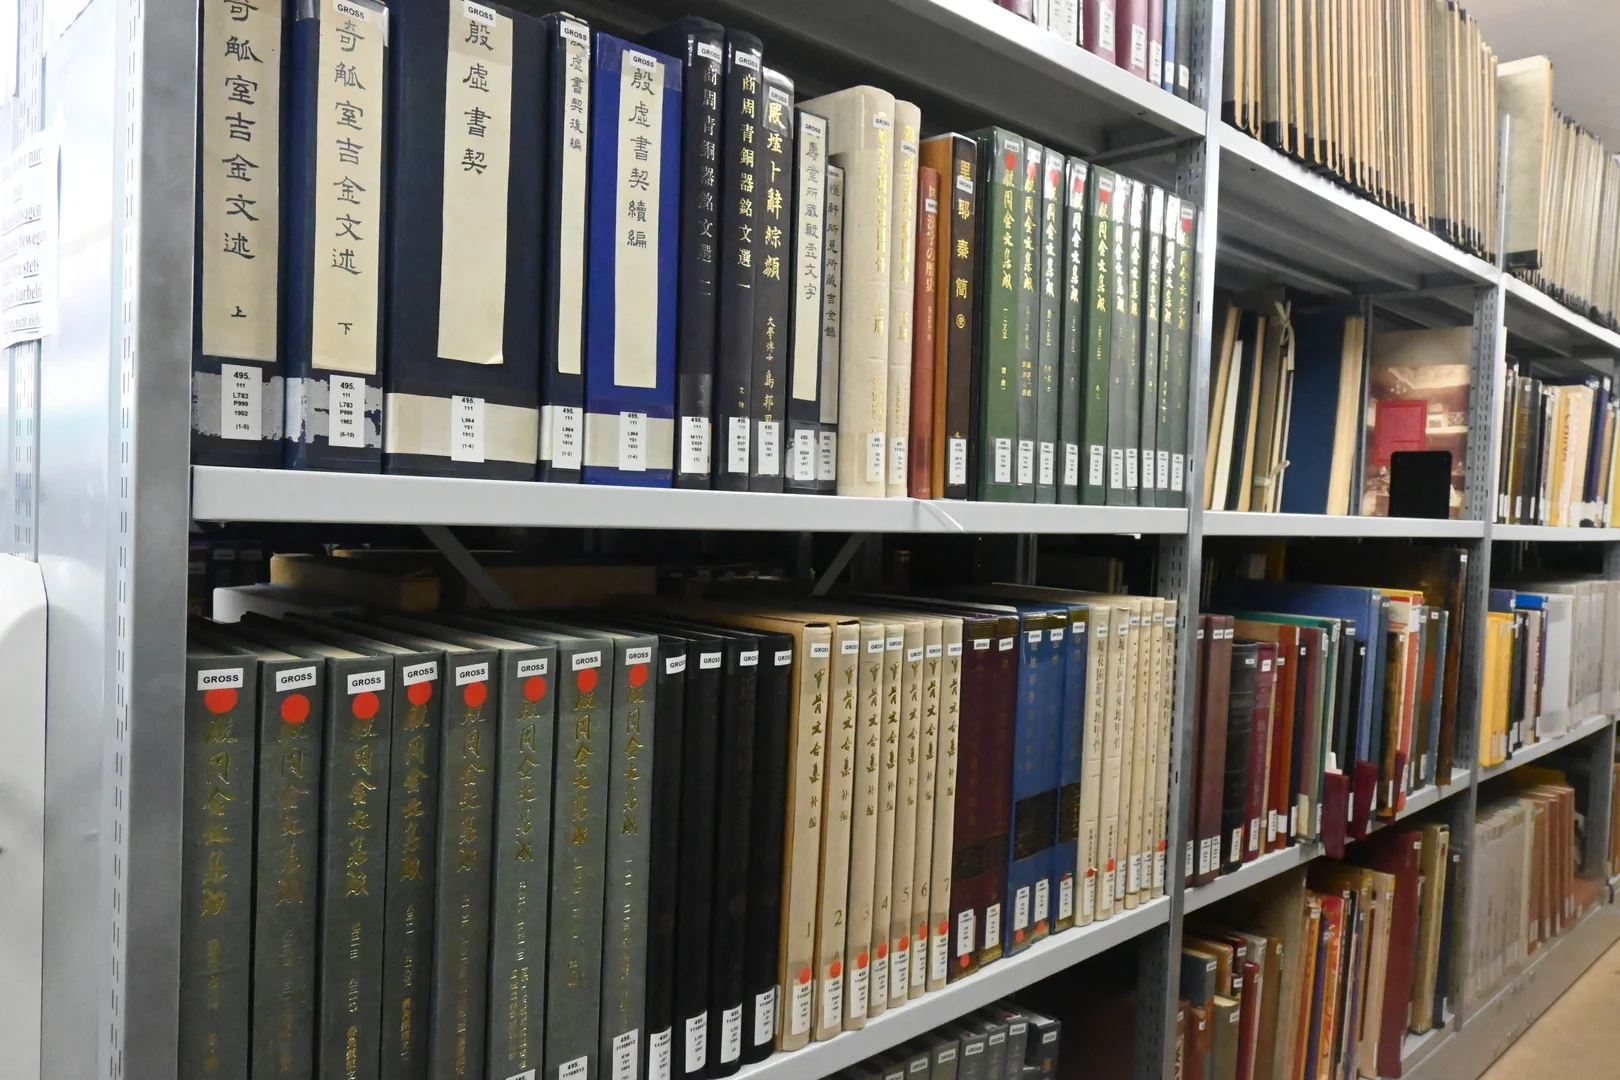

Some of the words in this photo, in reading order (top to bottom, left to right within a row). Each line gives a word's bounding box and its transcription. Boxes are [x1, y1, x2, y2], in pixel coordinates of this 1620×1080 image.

[337, 3, 365, 19] GROSS
[468, 7, 494, 21] GROSS
[564, 27, 587, 41] GROSS
[702, 48, 720, 60] GROSS
[633, 56, 654, 68] GROSS
[739, 57, 758, 68] GROSS
[771, 92, 787, 103] GROSS
[805, 123, 821, 134] GROSS
[331, 20, 367, 275] 奇觚室吉金文述
[737, 74, 756, 268] 商周青銅器銘文選
[23, 259, 39, 274] stets
[231, 306, 247, 318] 上
[338, 322, 353, 335] 下
[233, 371, 250, 380] 495.
[340, 382, 355, 390] 495.
[339, 401, 353, 409] L783
[576, 656, 598, 665] GROSS
[407, 667, 434, 678] GROSS
[459, 669, 486, 679] GROSS
[521, 664, 544, 672] GROSS
[203, 674, 239, 684] GROSS
[281, 673, 312, 684] GROSS
[352, 677, 381, 687] GROSS
[908, 660, 920, 766] 甲骨文合集
[926, 658, 938, 760] 甲骨文合集
[947, 656, 958, 757] 甲骨文合集
[840, 664, 856, 778] 甲骨文合集
[866, 663, 880, 774] 甲骨文合集
[886, 661, 900, 770] 甲骨文合集
[809, 668, 826, 784] 甲骨文合集
[902, 887, 909, 902] 5
[921, 881, 928, 897] 6
[881, 896, 888, 910] 4
[834, 909, 842, 927] 2
[806, 922, 811, 938] 1
[621, 1035, 630, 1043] 495.
[568, 1062, 580, 1070] 495.
